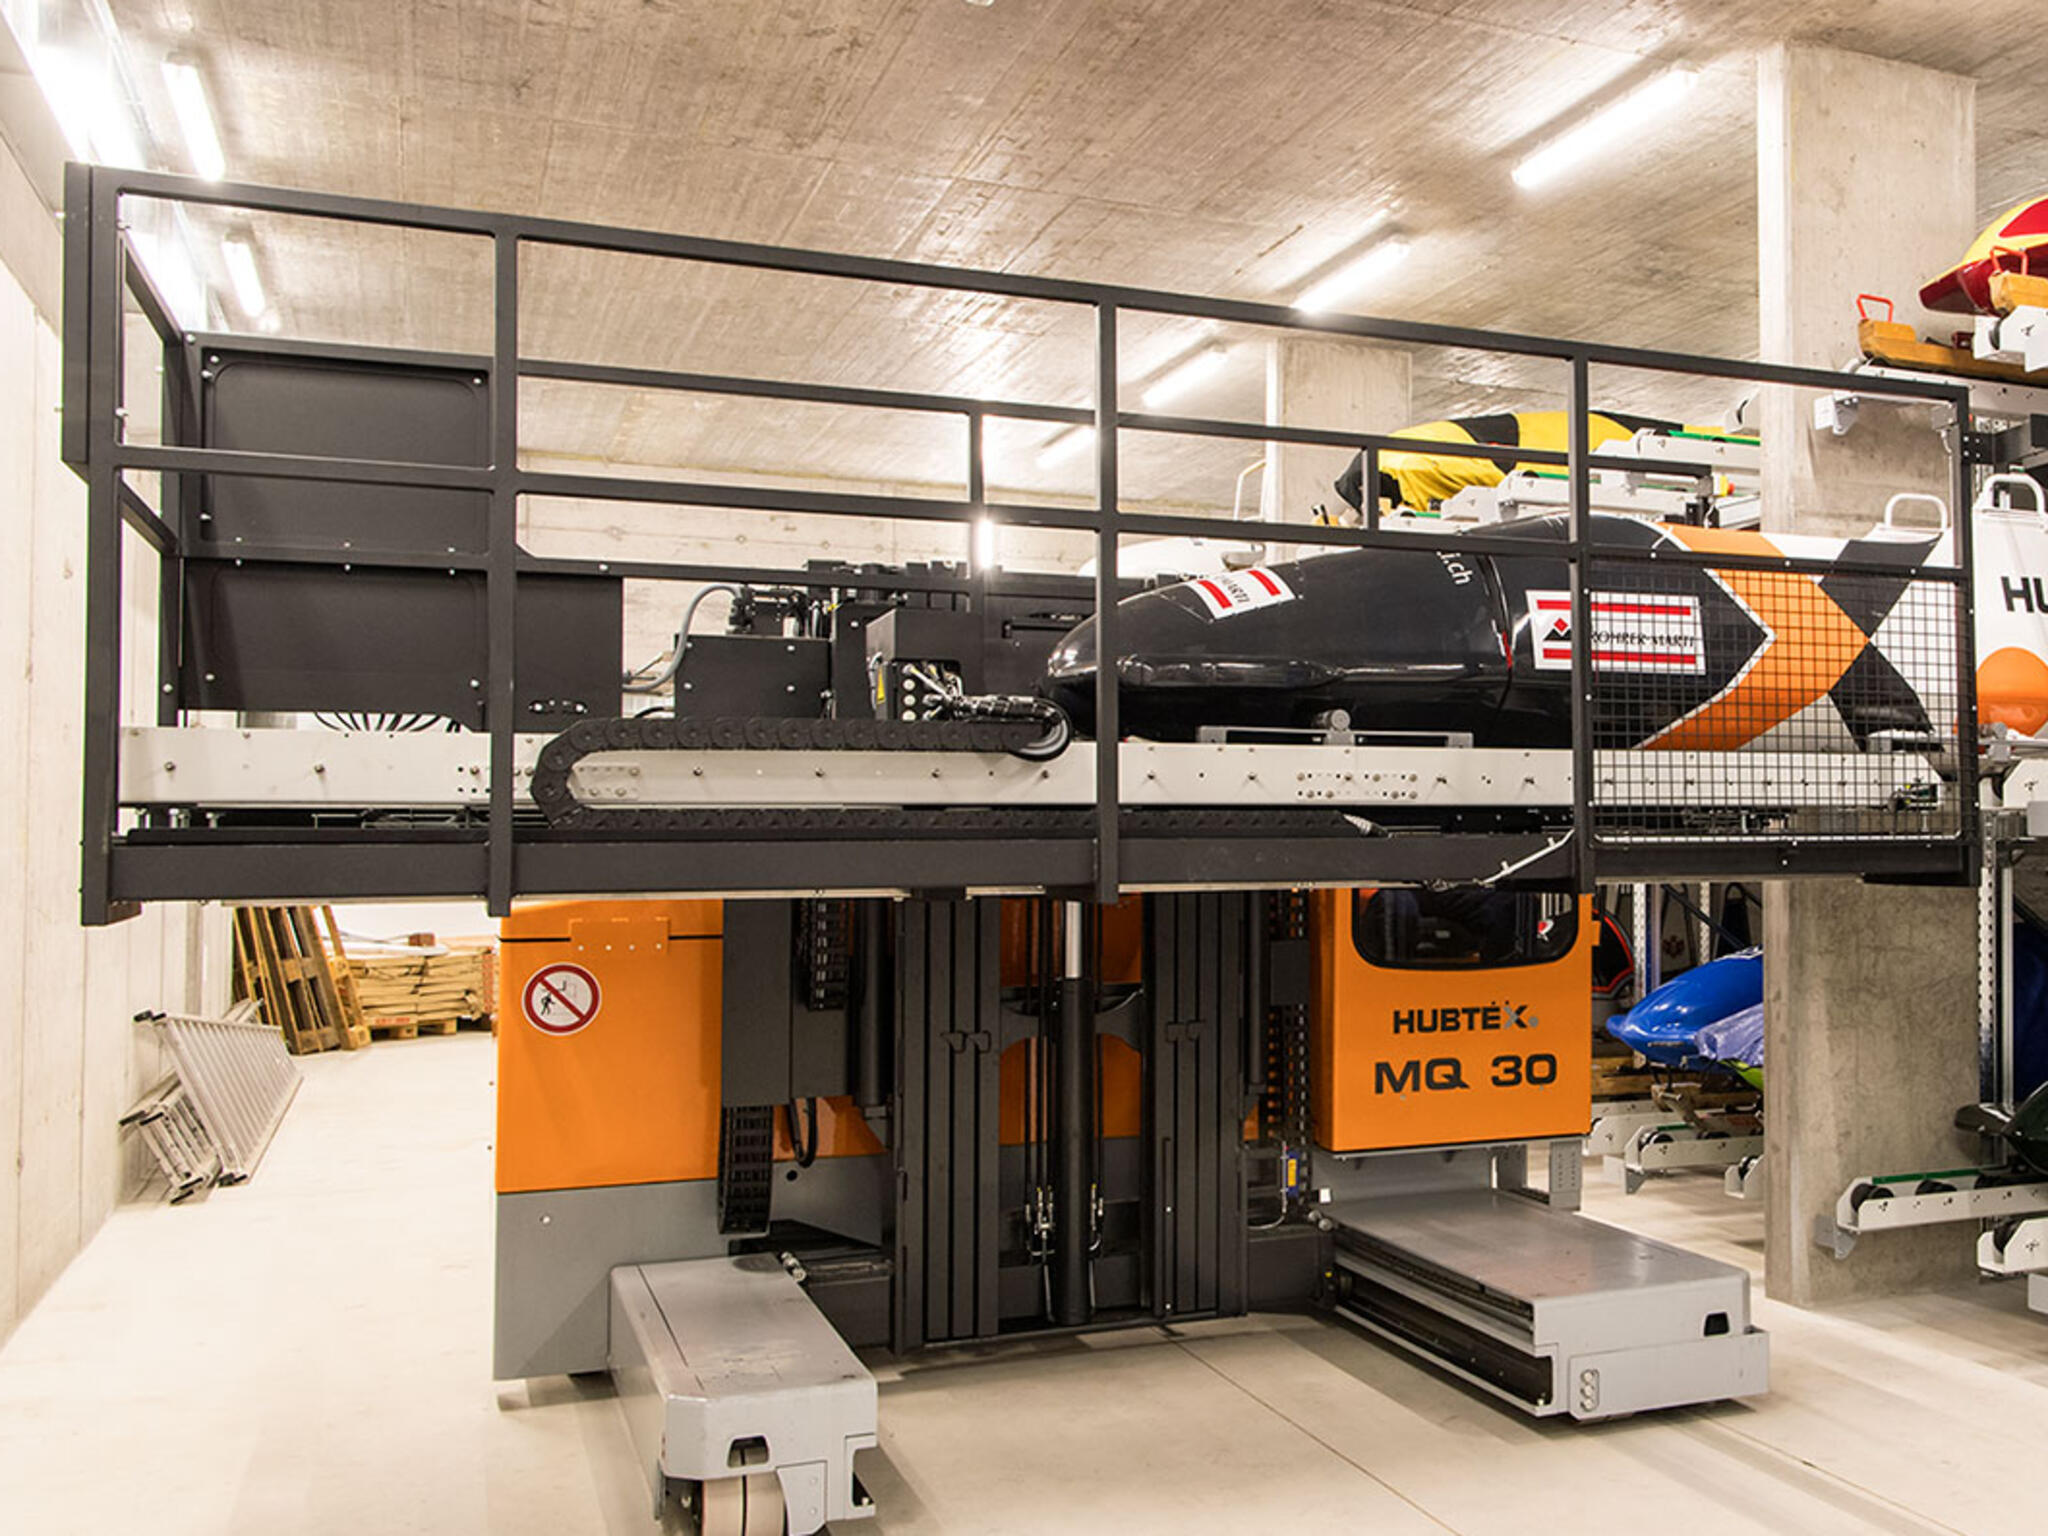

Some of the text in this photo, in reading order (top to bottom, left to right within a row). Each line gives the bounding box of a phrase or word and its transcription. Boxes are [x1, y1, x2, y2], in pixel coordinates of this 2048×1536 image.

[1393, 1001, 1528, 1034] HUBTEX
[1375, 1053, 1557, 1094] MQ 30
